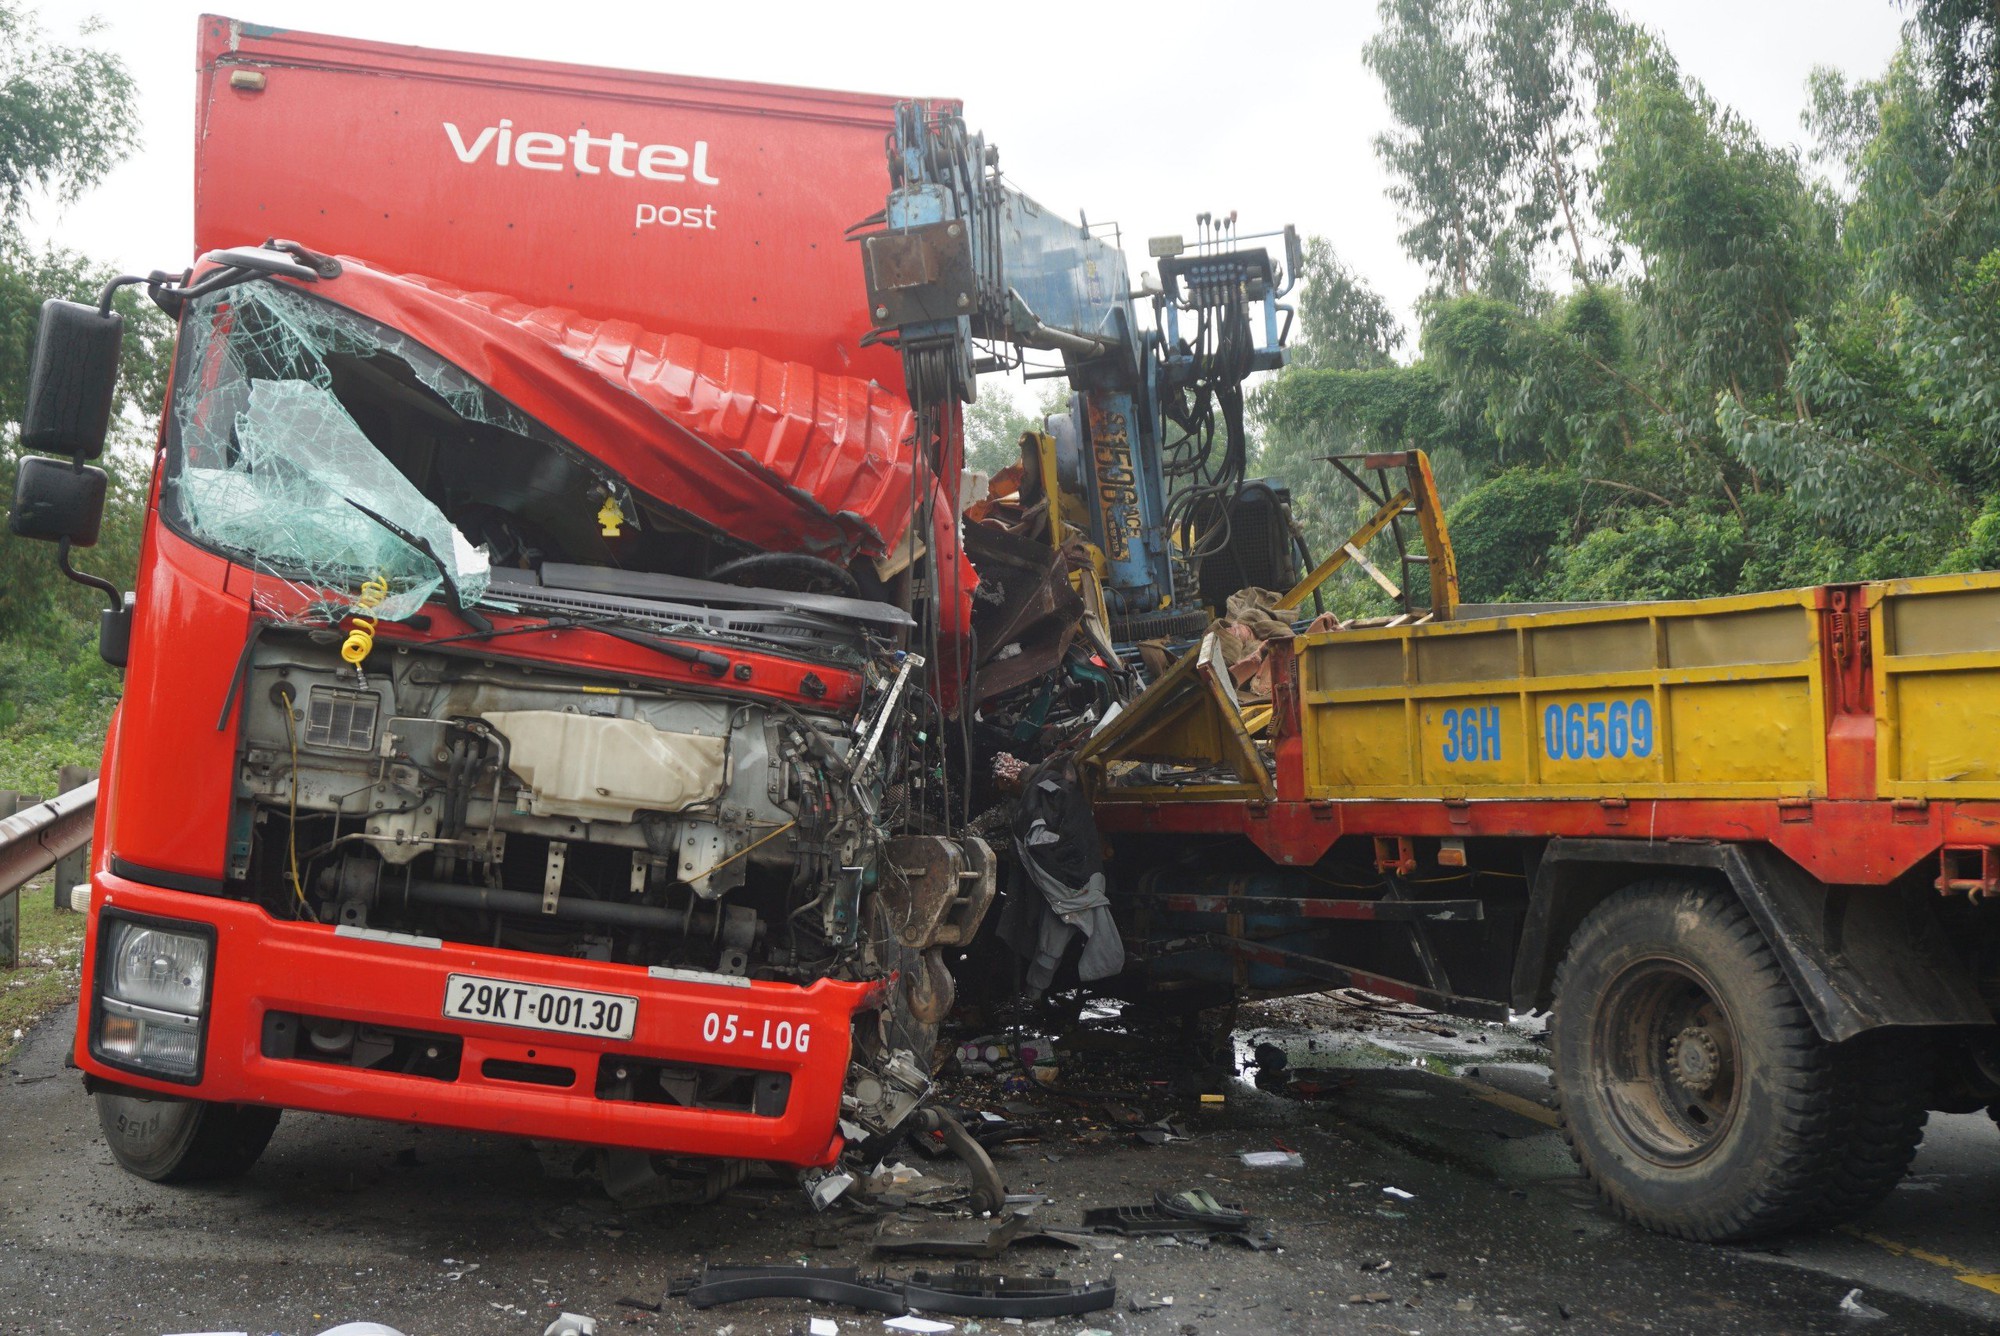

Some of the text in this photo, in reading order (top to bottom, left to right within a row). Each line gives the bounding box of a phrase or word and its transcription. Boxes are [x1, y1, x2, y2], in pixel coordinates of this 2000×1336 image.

[443, 118, 719, 185] viettel
[635, 203, 718, 230] post
[1442, 698, 1654, 762] 36H 06569
[457, 982, 623, 1032] 29KT-001.30
[702, 1012, 810, 1053] 05-LOG
